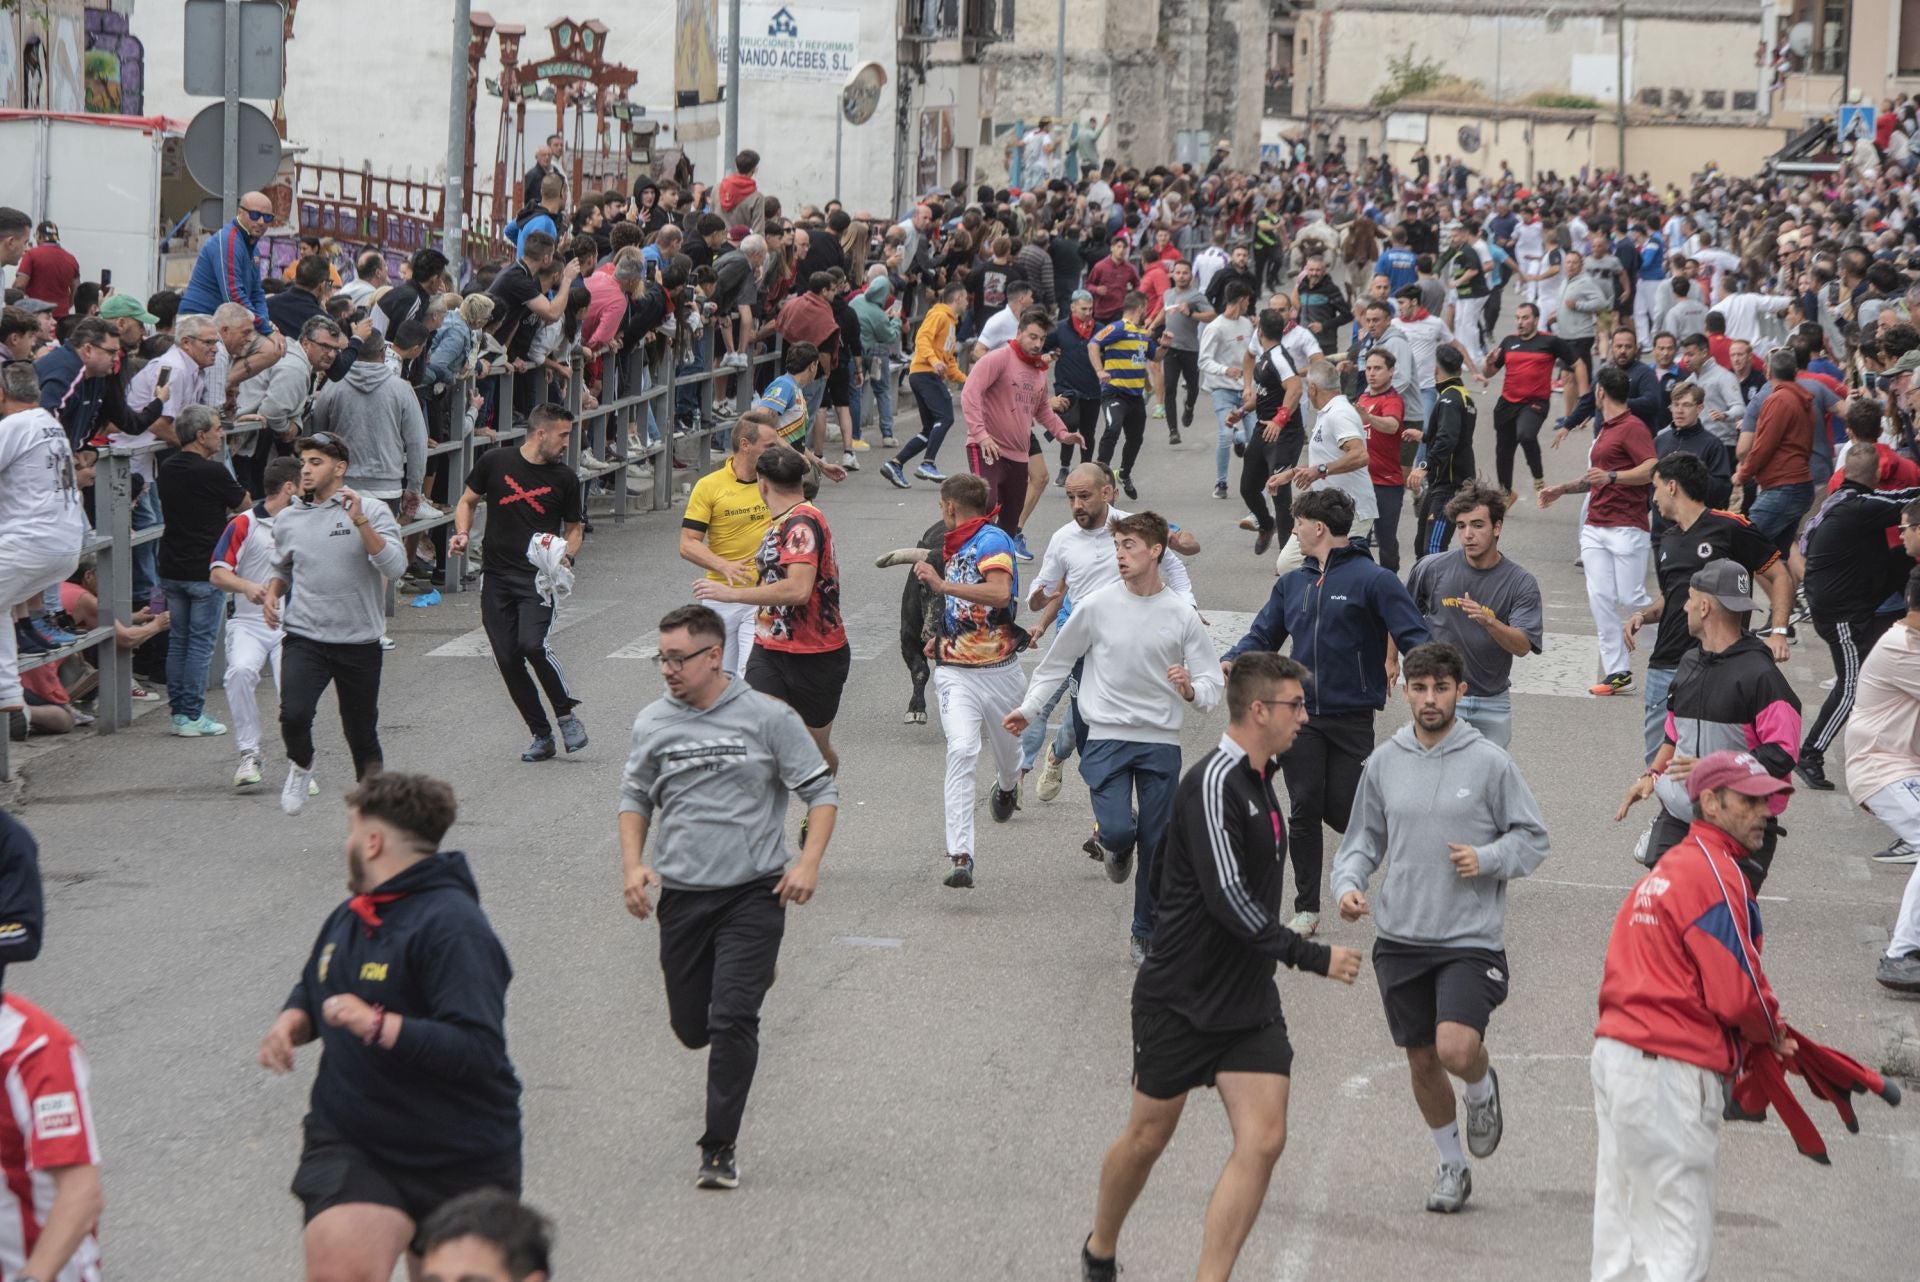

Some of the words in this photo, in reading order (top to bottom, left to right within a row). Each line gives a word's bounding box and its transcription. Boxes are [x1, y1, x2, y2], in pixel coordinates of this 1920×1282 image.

[718, 36, 795, 49] OTRUCCIONES
[805, 41, 854, 52] REFORMAS
[718, 48, 777, 66] HENANDO
[780, 50, 829, 71] ACEBES,
[832, 52, 853, 71] S.L.
[724, 508, 750, 517] Asados
[712, 747, 727, 755] you
